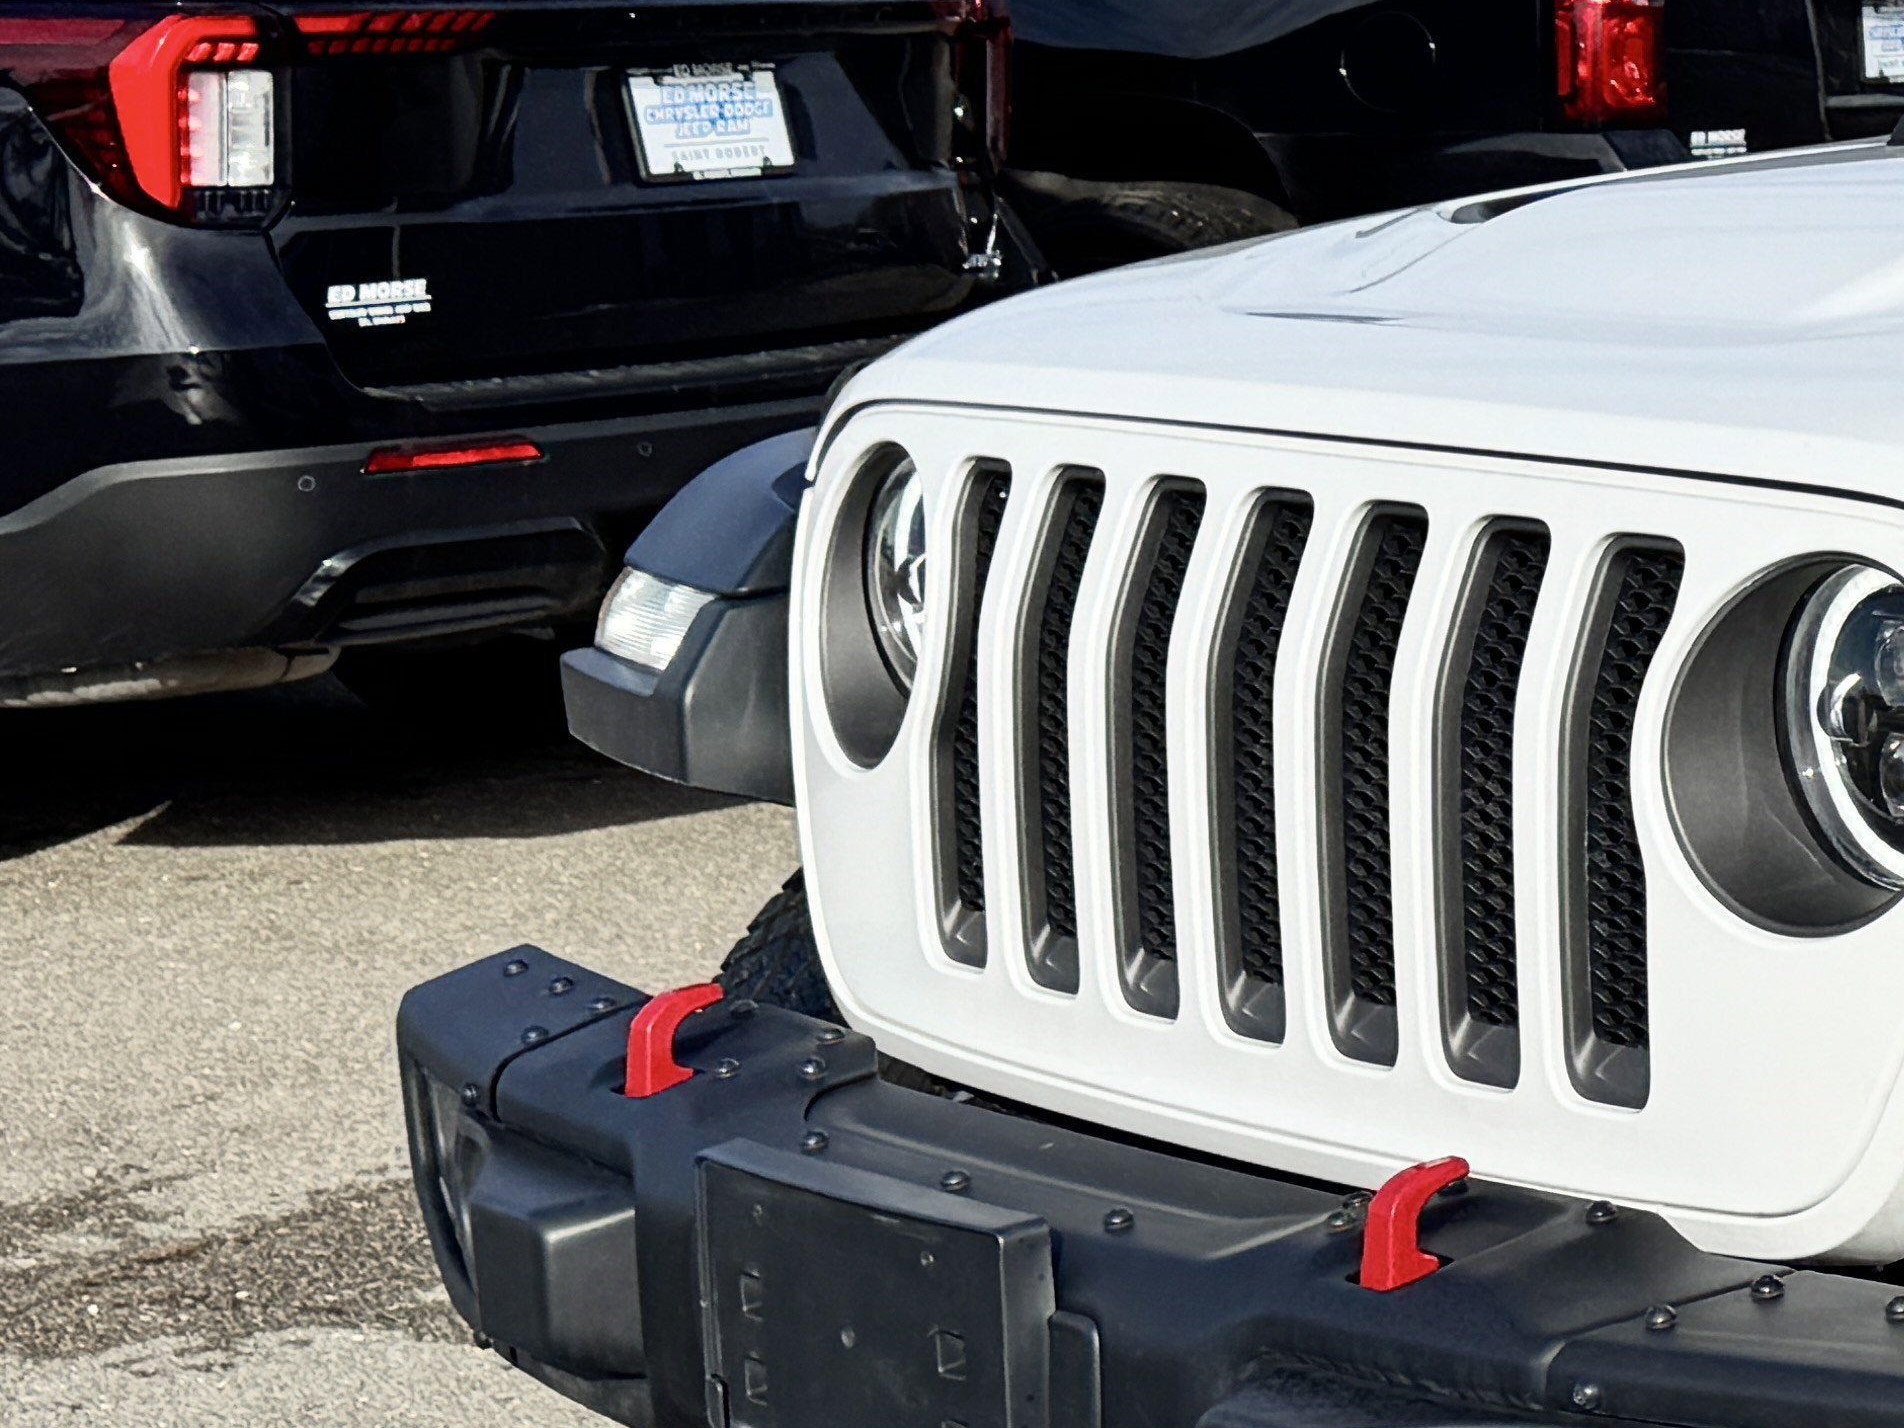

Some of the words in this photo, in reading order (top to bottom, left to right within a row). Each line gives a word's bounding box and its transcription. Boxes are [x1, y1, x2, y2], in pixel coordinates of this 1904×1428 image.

[661, 85, 685, 104] ED
[688, 81, 754, 103] MORSE
[646, 104, 719, 122] CHRYSLER
[327, 284, 356, 304] ED
[359, 278, 427, 300] MORSE
